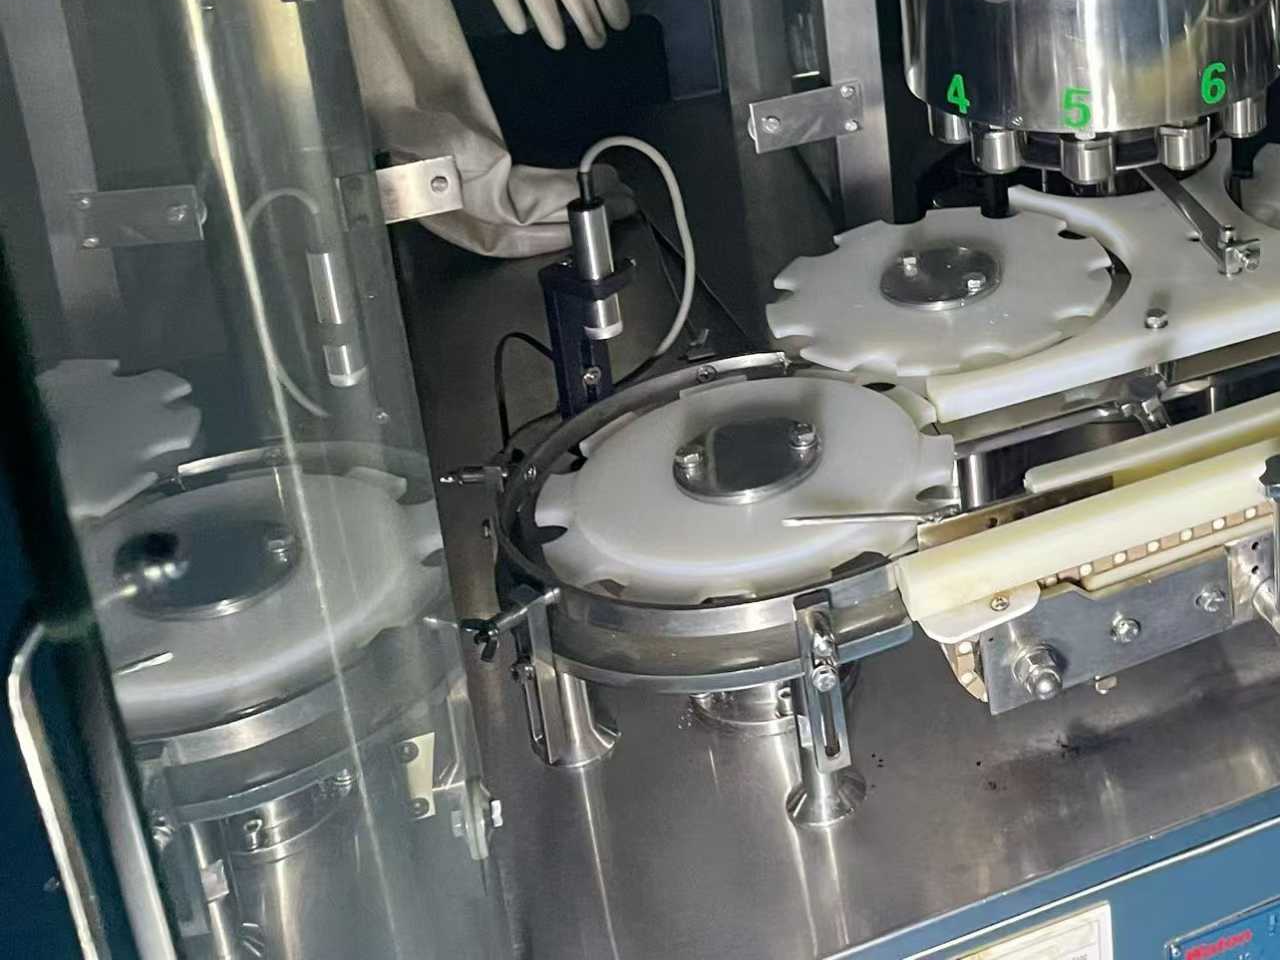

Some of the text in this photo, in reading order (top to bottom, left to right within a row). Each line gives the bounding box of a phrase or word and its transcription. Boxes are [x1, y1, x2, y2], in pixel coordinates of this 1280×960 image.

[946, 73, 970, 114] 4
[1201, 62, 1227, 104] 6
[1062, 87, 1092, 130] 5
